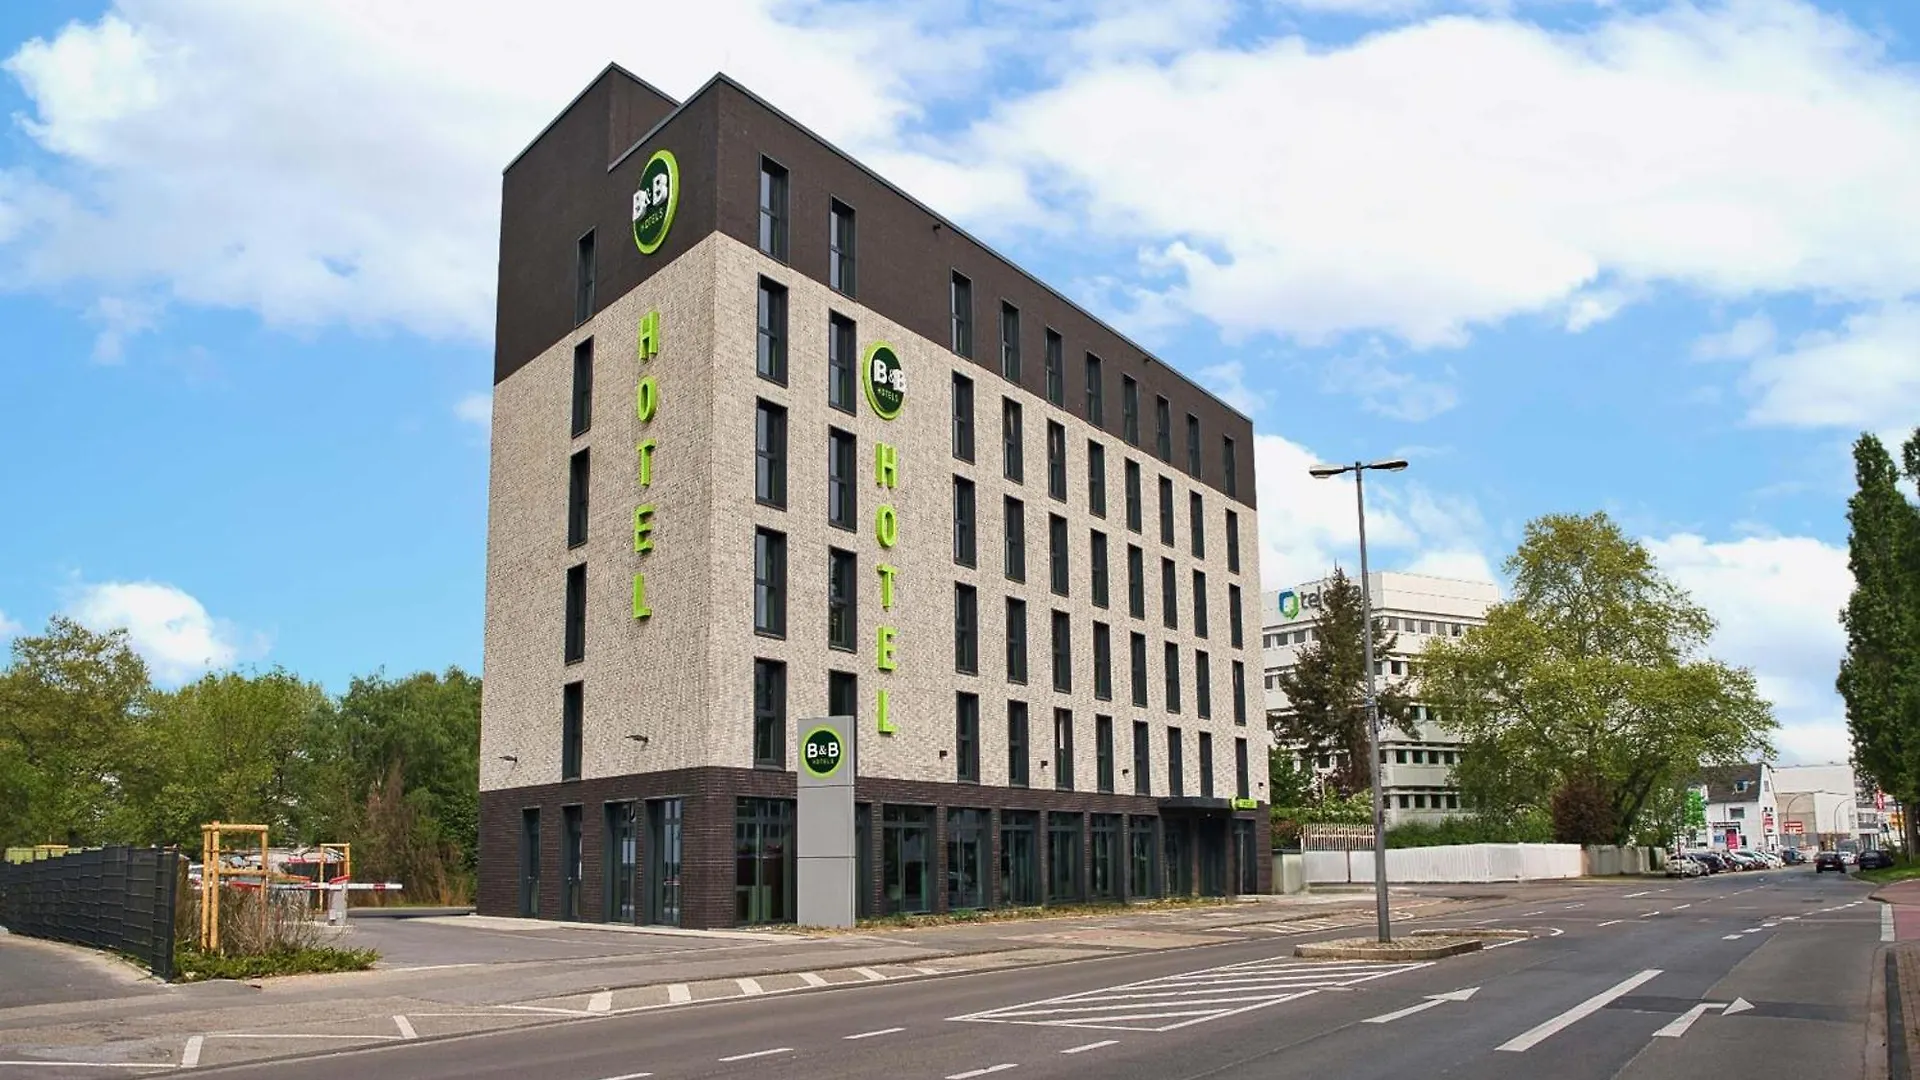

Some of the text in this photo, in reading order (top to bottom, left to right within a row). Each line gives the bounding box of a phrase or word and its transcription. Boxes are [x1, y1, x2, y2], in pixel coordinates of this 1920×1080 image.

[632, 172, 669, 222] B&B
[873, 359, 907, 393] B&B
[633, 311, 660, 620] HOTEL
[877, 442, 898, 735] HOTEL
[807, 742, 840, 758] B&B
